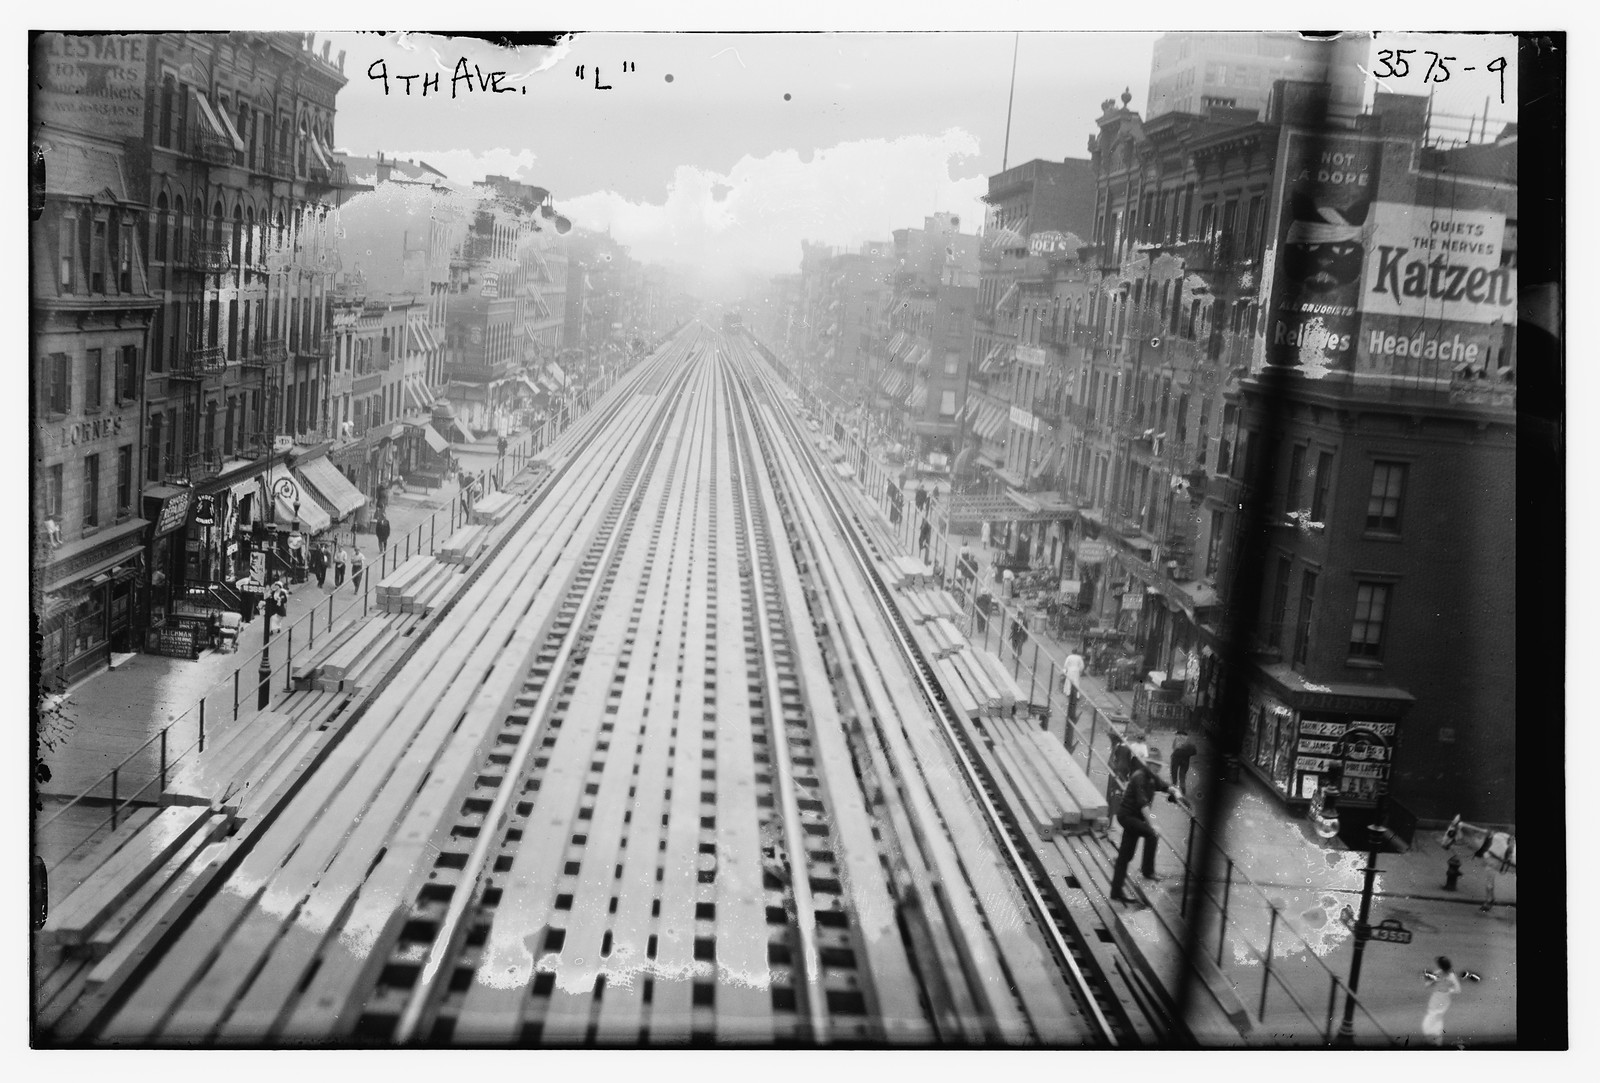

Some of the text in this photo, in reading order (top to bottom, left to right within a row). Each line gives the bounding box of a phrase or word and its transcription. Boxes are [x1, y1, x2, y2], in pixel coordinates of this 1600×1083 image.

[1320, 151, 1357, 167] NOT
[1298, 169, 1370, 187] A DOPE
[1430, 220, 1486, 237] QUIETS
[1412, 236, 1496, 256] THE NERVES
[1372, 244, 1515, 308] Katzen
[1273, 319, 1352, 353] Relves
[1368, 329, 1480, 364] Headache
